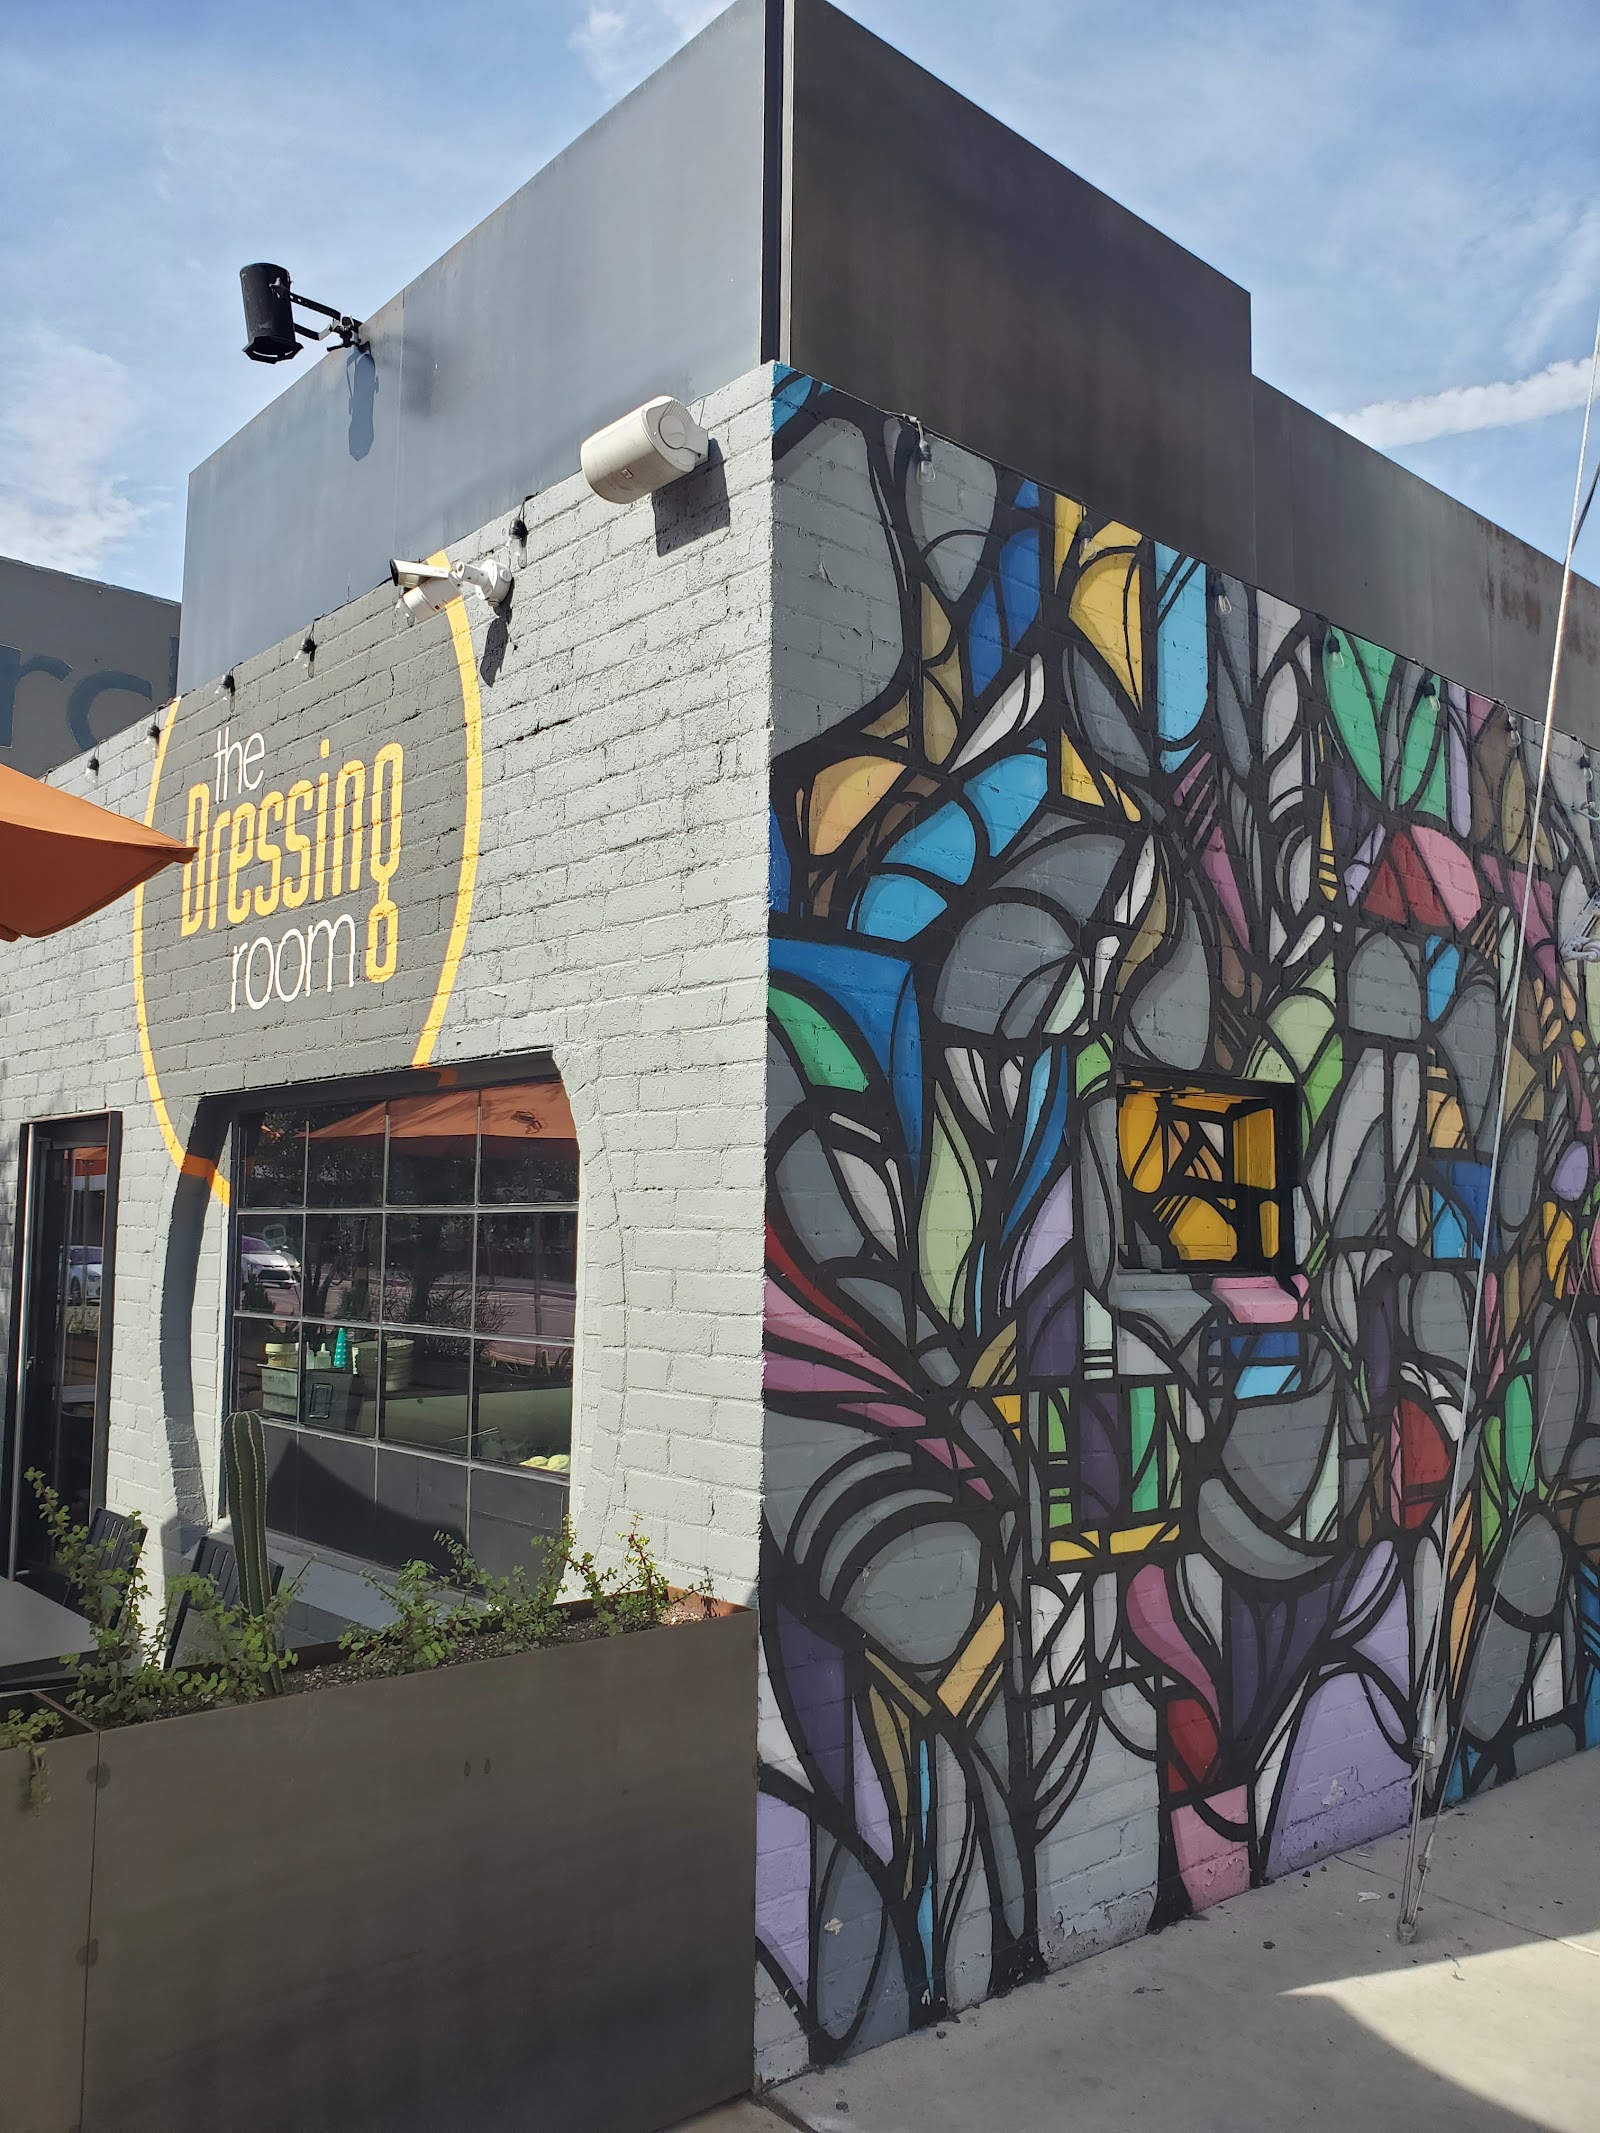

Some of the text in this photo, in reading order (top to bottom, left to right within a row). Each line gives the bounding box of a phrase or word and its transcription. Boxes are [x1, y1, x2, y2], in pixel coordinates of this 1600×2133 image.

[0, 634, 180, 750] rc
[214, 727, 265, 804] the
[180, 739, 403, 983] Dressing
[231, 914, 356, 1013] room
